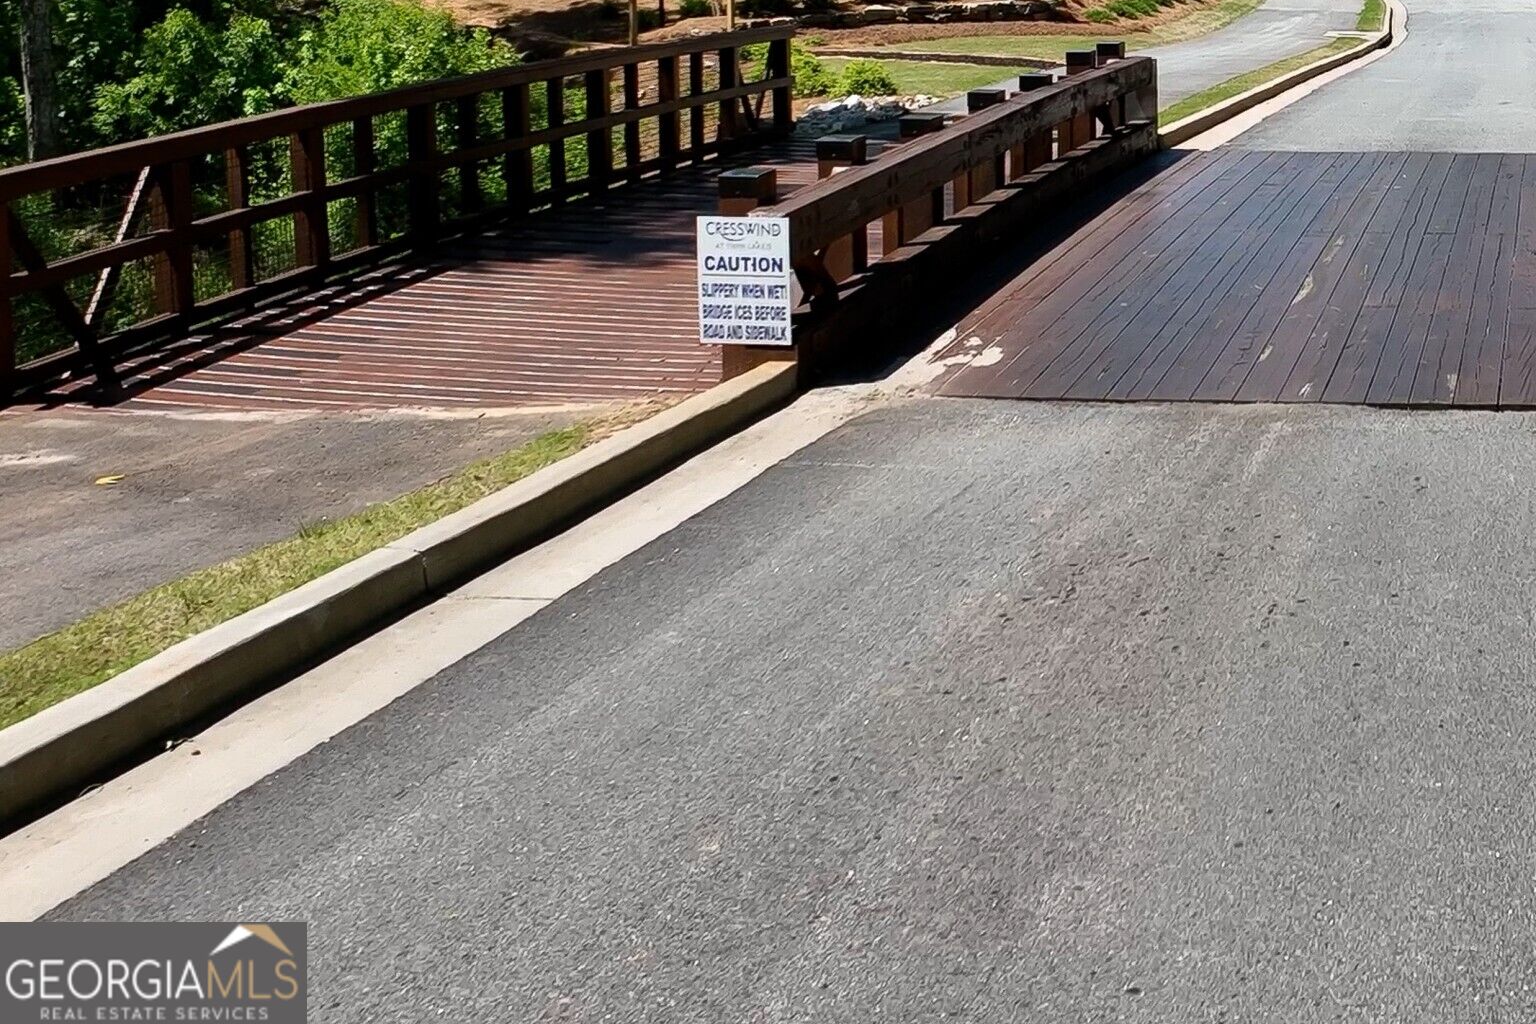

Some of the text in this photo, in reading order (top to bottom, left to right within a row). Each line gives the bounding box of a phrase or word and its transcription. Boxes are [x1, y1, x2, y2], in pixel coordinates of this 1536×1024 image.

[705, 221, 781, 237] CRESSWIND
[704, 255, 783, 272] CAUTION
[702, 283, 738, 297] SLIPPERY
[742, 284, 765, 298] WHEN
[703, 304, 787, 321] BRIDGE ICES BEFORE
[703, 324, 787, 341] ROAD AND SIDEWALK
